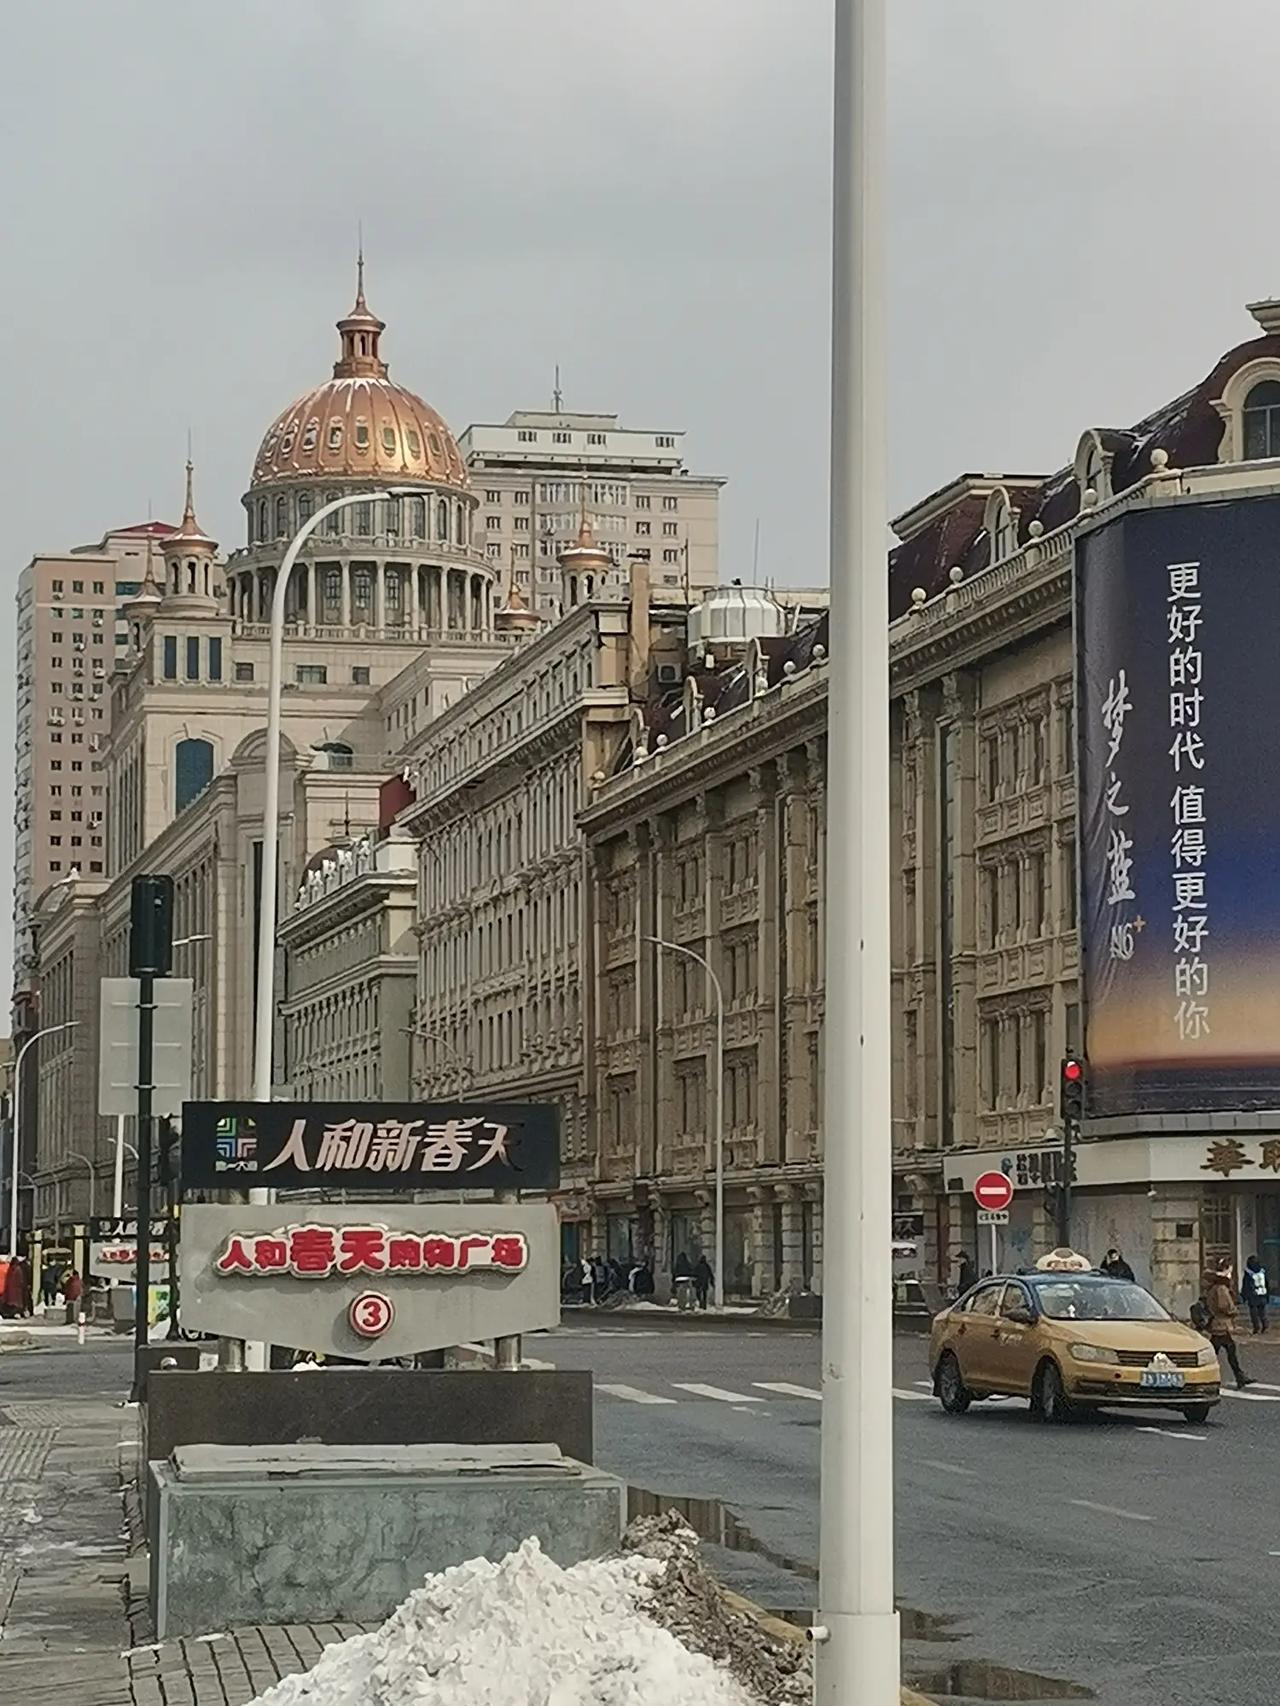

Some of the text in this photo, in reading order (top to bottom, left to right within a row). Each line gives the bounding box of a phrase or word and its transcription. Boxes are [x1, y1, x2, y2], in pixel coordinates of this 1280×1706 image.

[1101, 669, 1136, 905] 梦之蓝
[1166, 562, 1210, 1040] 更好的时代 值得更好的你
[262, 1116, 525, 1172] 人和新春天
[219, 1229, 523, 1272] 人和春天购物广场
[362, 1301, 382, 1328] 3
